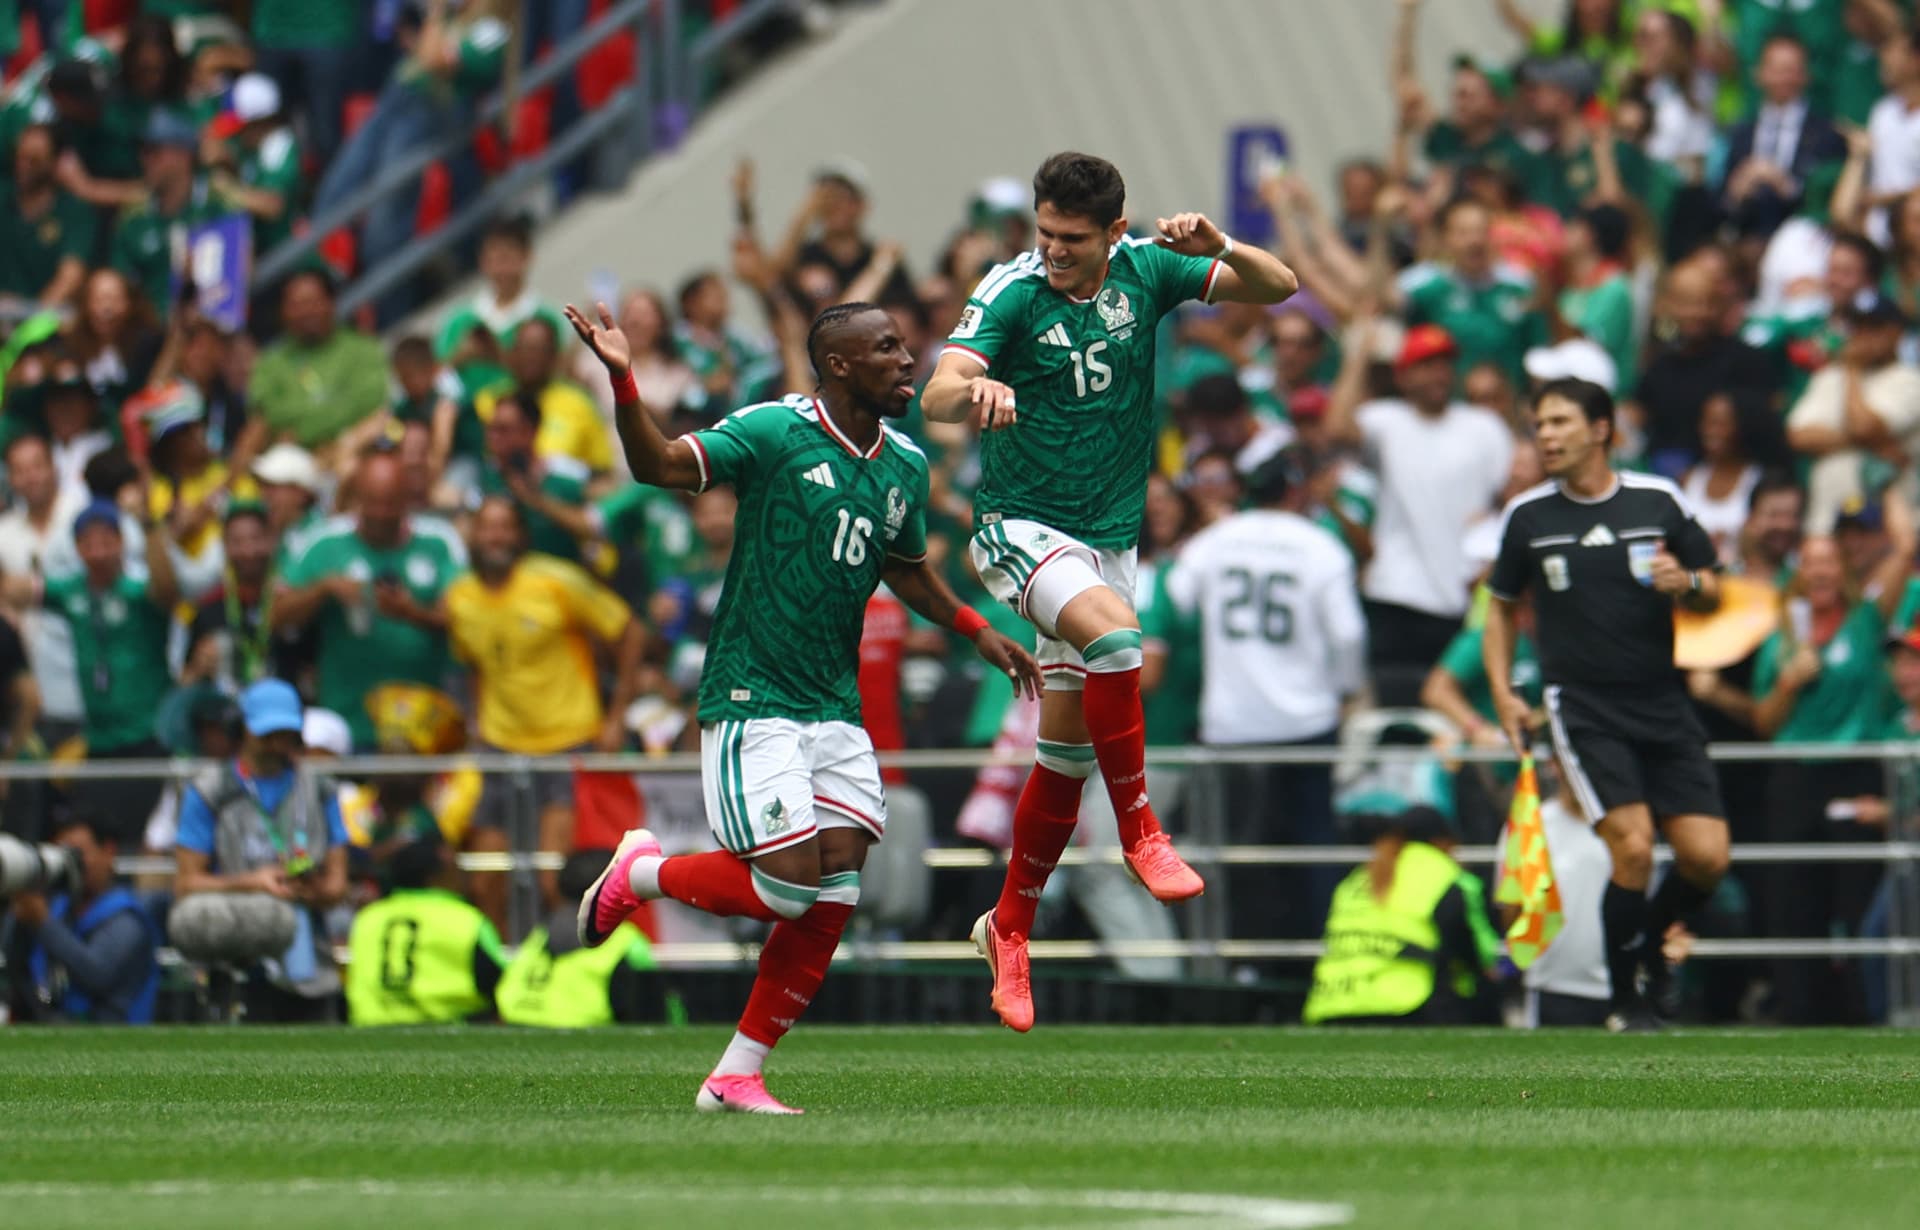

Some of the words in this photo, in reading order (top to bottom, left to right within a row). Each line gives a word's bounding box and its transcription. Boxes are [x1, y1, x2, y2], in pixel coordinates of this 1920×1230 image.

[1070, 340, 1113, 398] 15
[832, 508, 873, 566] 16
[1221, 566, 1299, 645] 26
